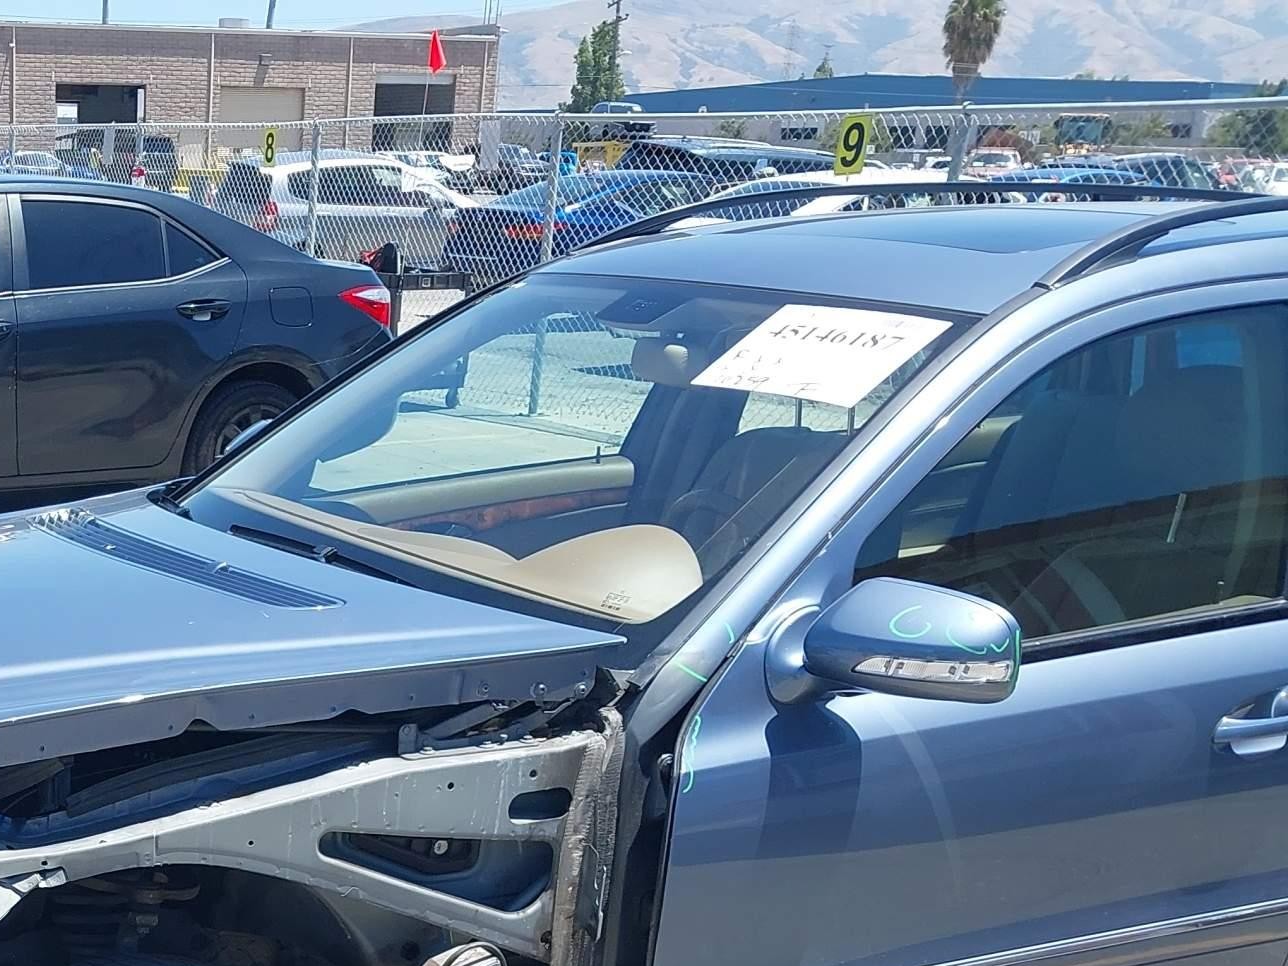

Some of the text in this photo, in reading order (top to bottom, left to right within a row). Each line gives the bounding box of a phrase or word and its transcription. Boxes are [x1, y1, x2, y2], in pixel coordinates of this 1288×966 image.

[265, 132, 275, 163] 8
[840, 122, 865, 168] 9
[769, 324, 905, 350] 45146187
